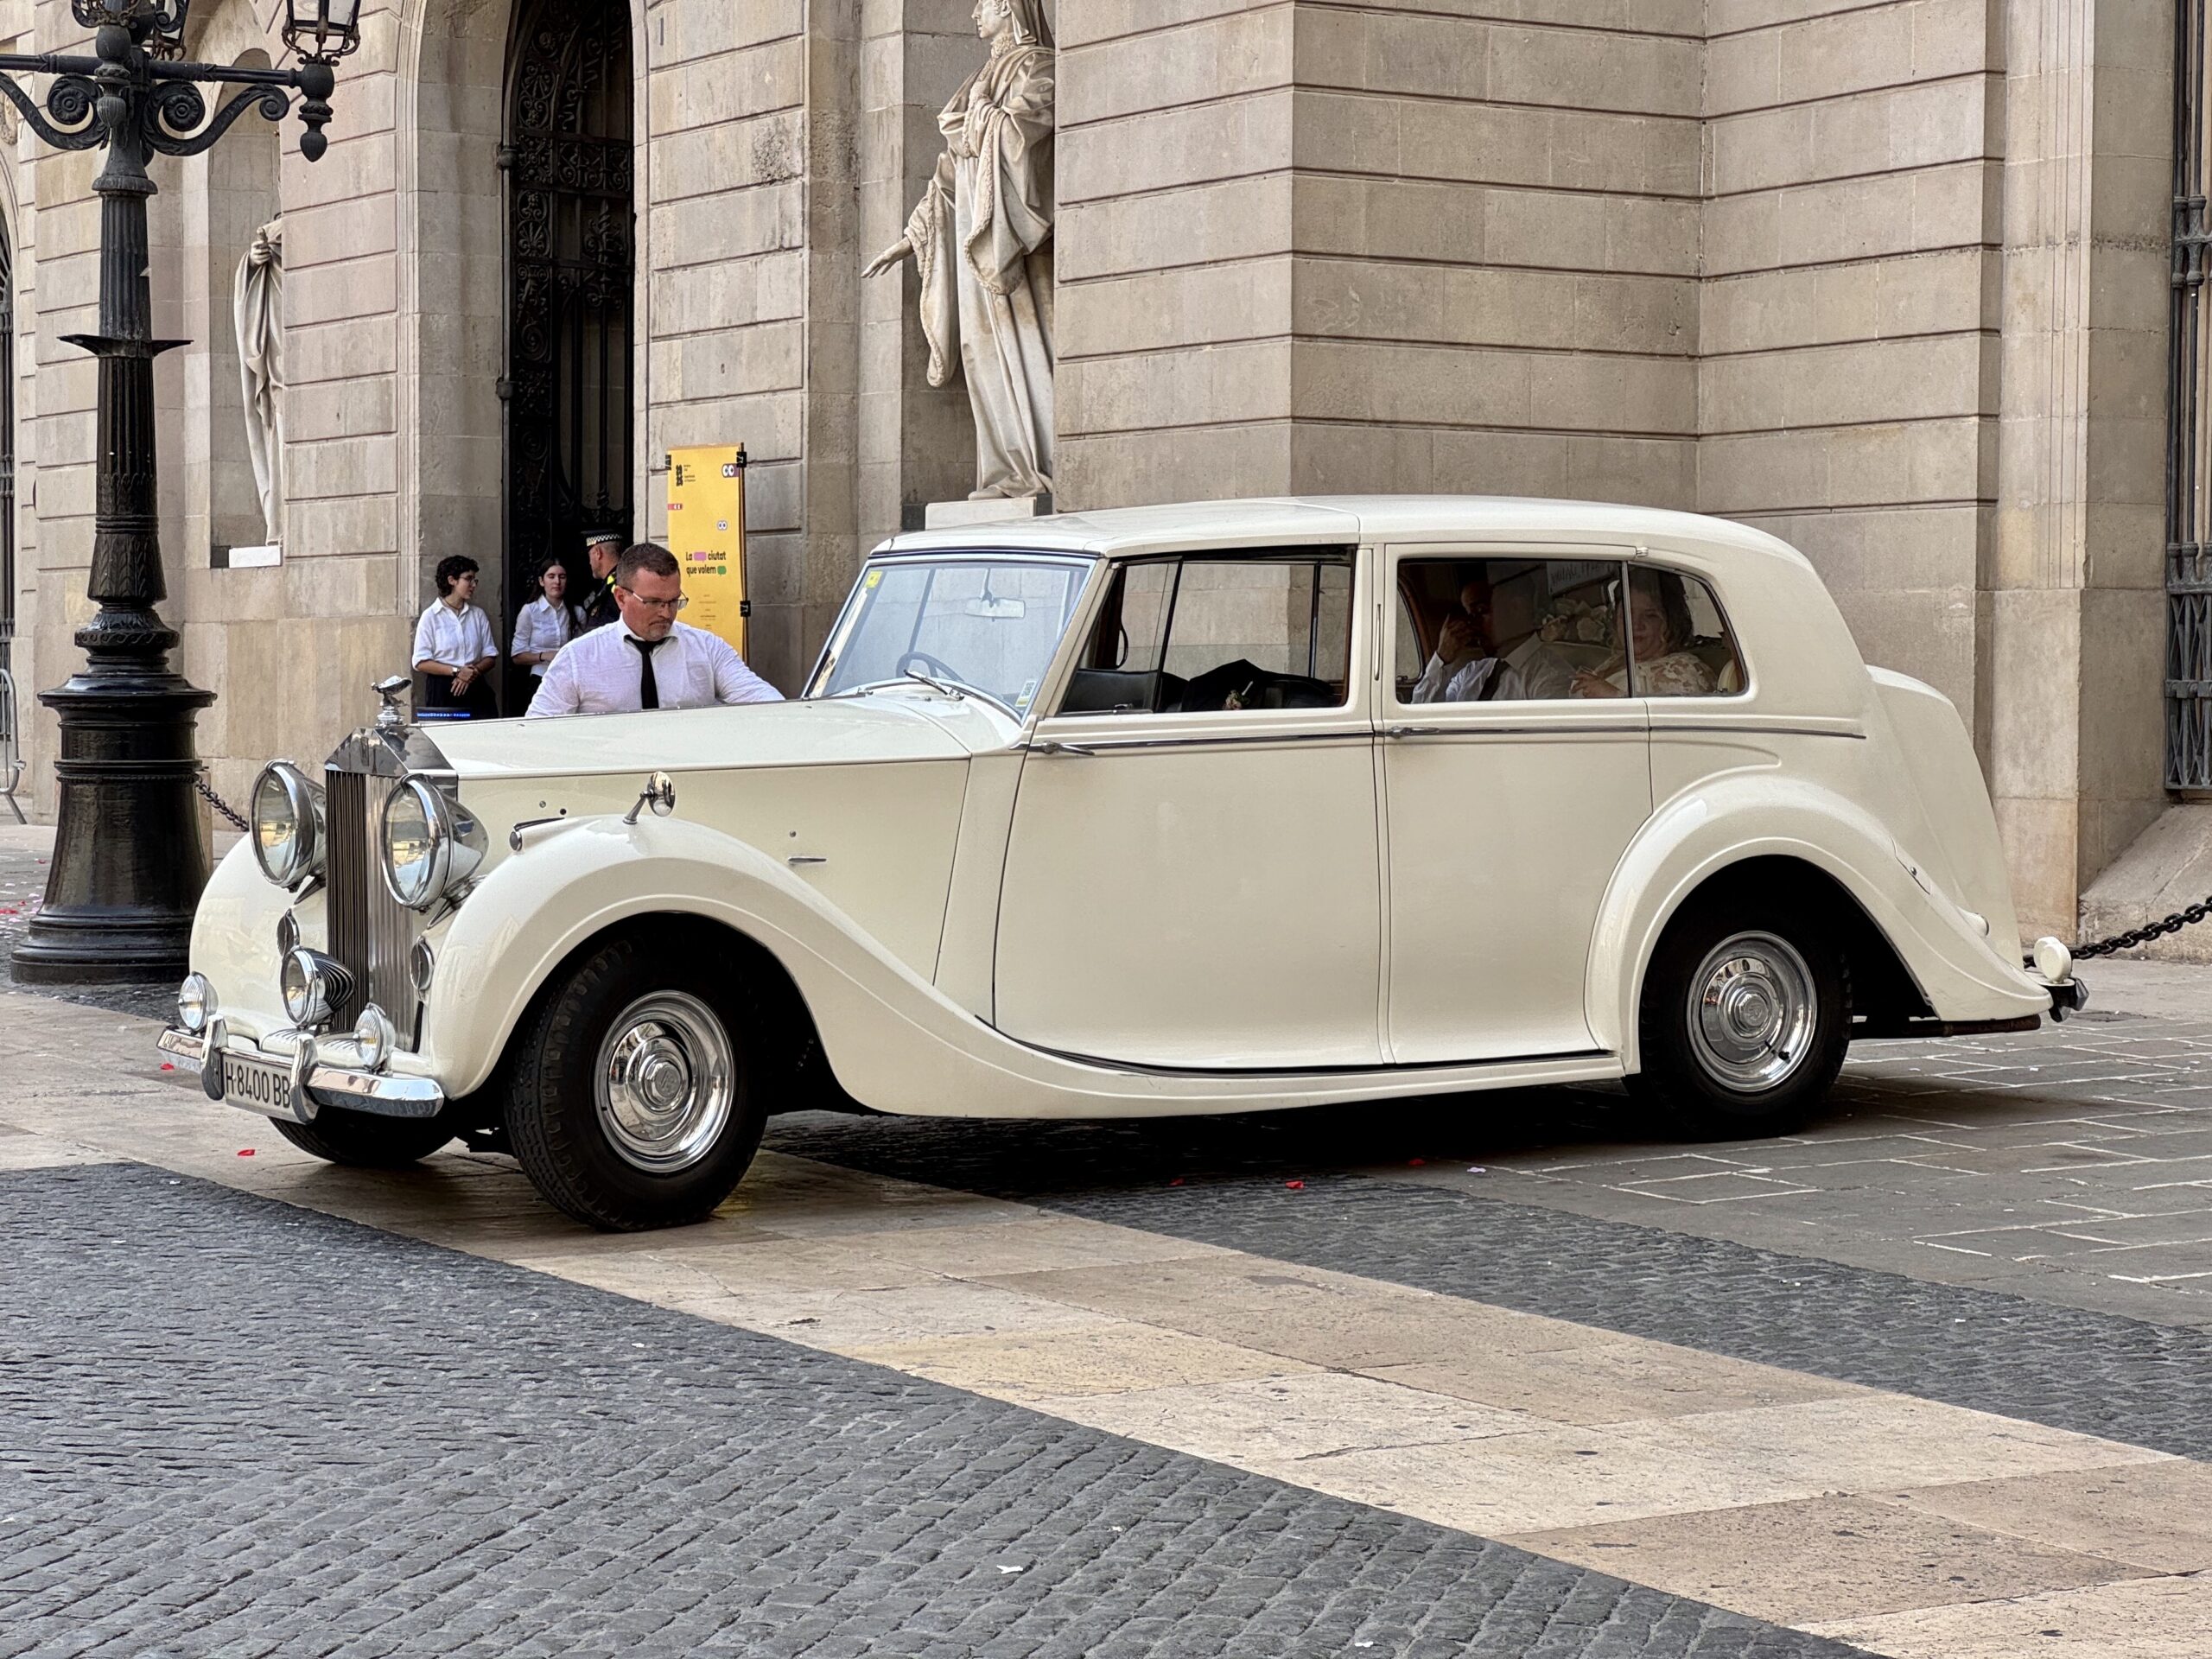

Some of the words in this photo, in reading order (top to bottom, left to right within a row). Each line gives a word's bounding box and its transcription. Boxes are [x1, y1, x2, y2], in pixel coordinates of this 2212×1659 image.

[685, 551, 693, 561] La
[708, 550, 727, 561] ciutat
[686, 566, 697, 577] que
[697, 564, 716, 575] volem
[225, 1062, 235, 1096] H
[237, 1064, 270, 1103] 8400
[273, 1073, 291, 1109] BB
